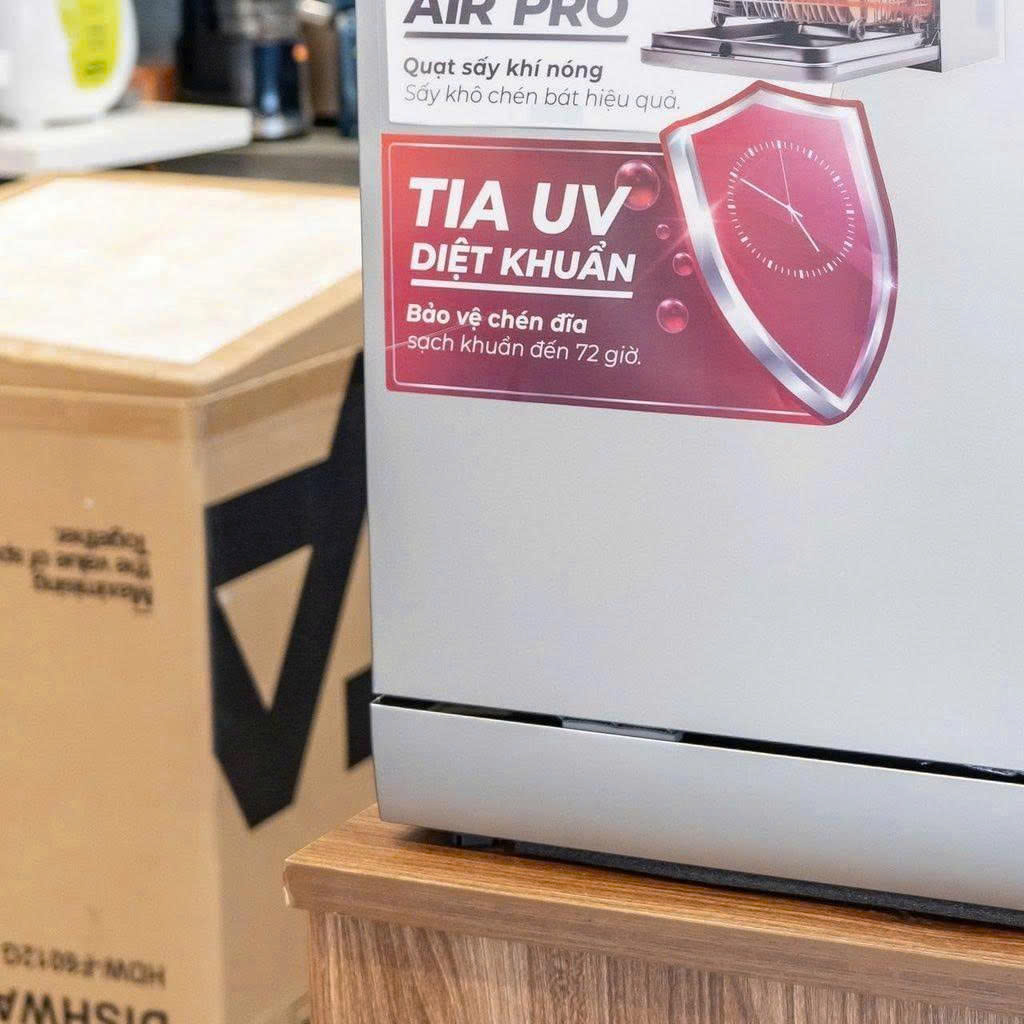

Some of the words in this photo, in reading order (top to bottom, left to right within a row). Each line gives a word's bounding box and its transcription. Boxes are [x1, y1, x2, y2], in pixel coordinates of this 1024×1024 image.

[403, 57, 455, 79] Quạt
[462, 56, 500, 79] sấy
[506, 58, 542, 77] khí
[547, 59, 603, 83] nóng
[404, 83, 440, 106] Sấy
[446, 84, 483, 104] khô
[488, 86, 538, 105] chén
[544, 87, 579, 107] bát
[585, 89, 629, 111] hiệu
[635, 89, 681, 113] quả.
[409, 176, 509, 232] TIA
[532, 182, 632, 236] UV
[410, 236, 493, 281] DIỆT
[500, 241, 636, 282] KHUẨN
[406, 302, 450, 324] Bảo
[457, 307, 482, 331] vệ
[488, 309, 543, 331] chén
[550, 313, 588, 334] đĩa
[408, 333, 454, 354] sạch
[461, 334, 524, 357] khuẩn
[530, 340, 569, 360] đến
[576, 343, 599, 362] 72
[604, 345, 641, 367] giờ.
